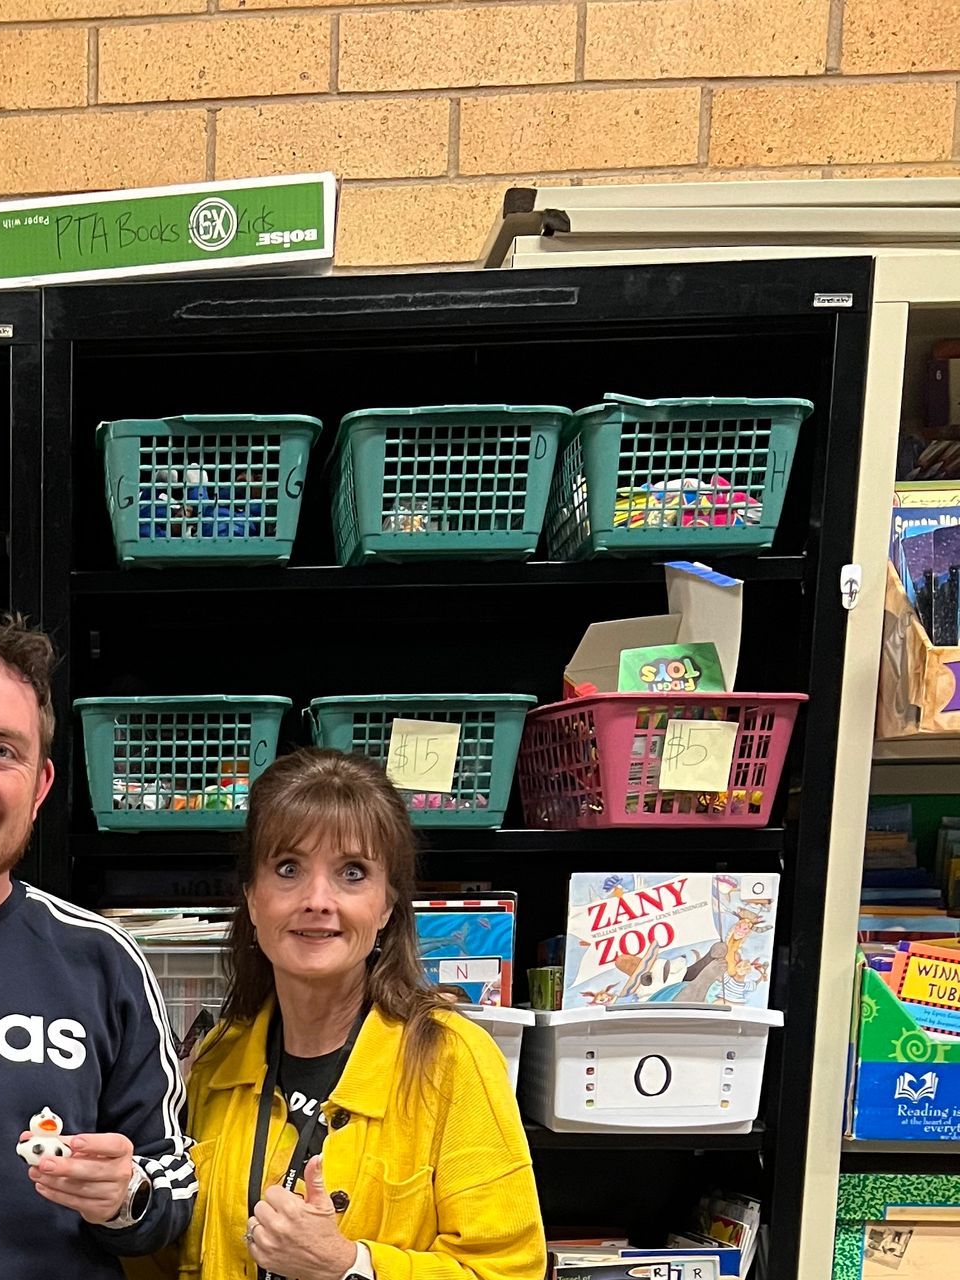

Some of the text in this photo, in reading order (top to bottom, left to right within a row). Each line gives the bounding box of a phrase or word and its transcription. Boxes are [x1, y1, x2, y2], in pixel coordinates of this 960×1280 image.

[3, 217, 22, 229] with
[24, 214, 51, 227] Paper
[54, 212, 109, 260] PTA
[114, 211, 180, 246] Books
[235, 202, 275, 240] Kids
[534, 434, 547, 460] D
[285, 466, 304, 499] G
[772, 450, 788, 493] H
[640, 657, 702, 684] TOYS
[254, 740, 268, 766] C
[393, 733, 439, 776] $15
[665, 724, 722, 771] $5
[752, 882, 765, 895] O
[588, 877, 688, 932] ZANY
[595, 921, 675, 966] ZOO
[457, 963, 469, 980] N
[929, 983, 960, 1002] TUB
[633, 1054, 672, 1097] O
[898, 1103, 949, 1119] Reading
[923, 1117, 942, 1125] heart
[653, 1267, 667, 1278] R
[693, 1267, 703, 1280] R
